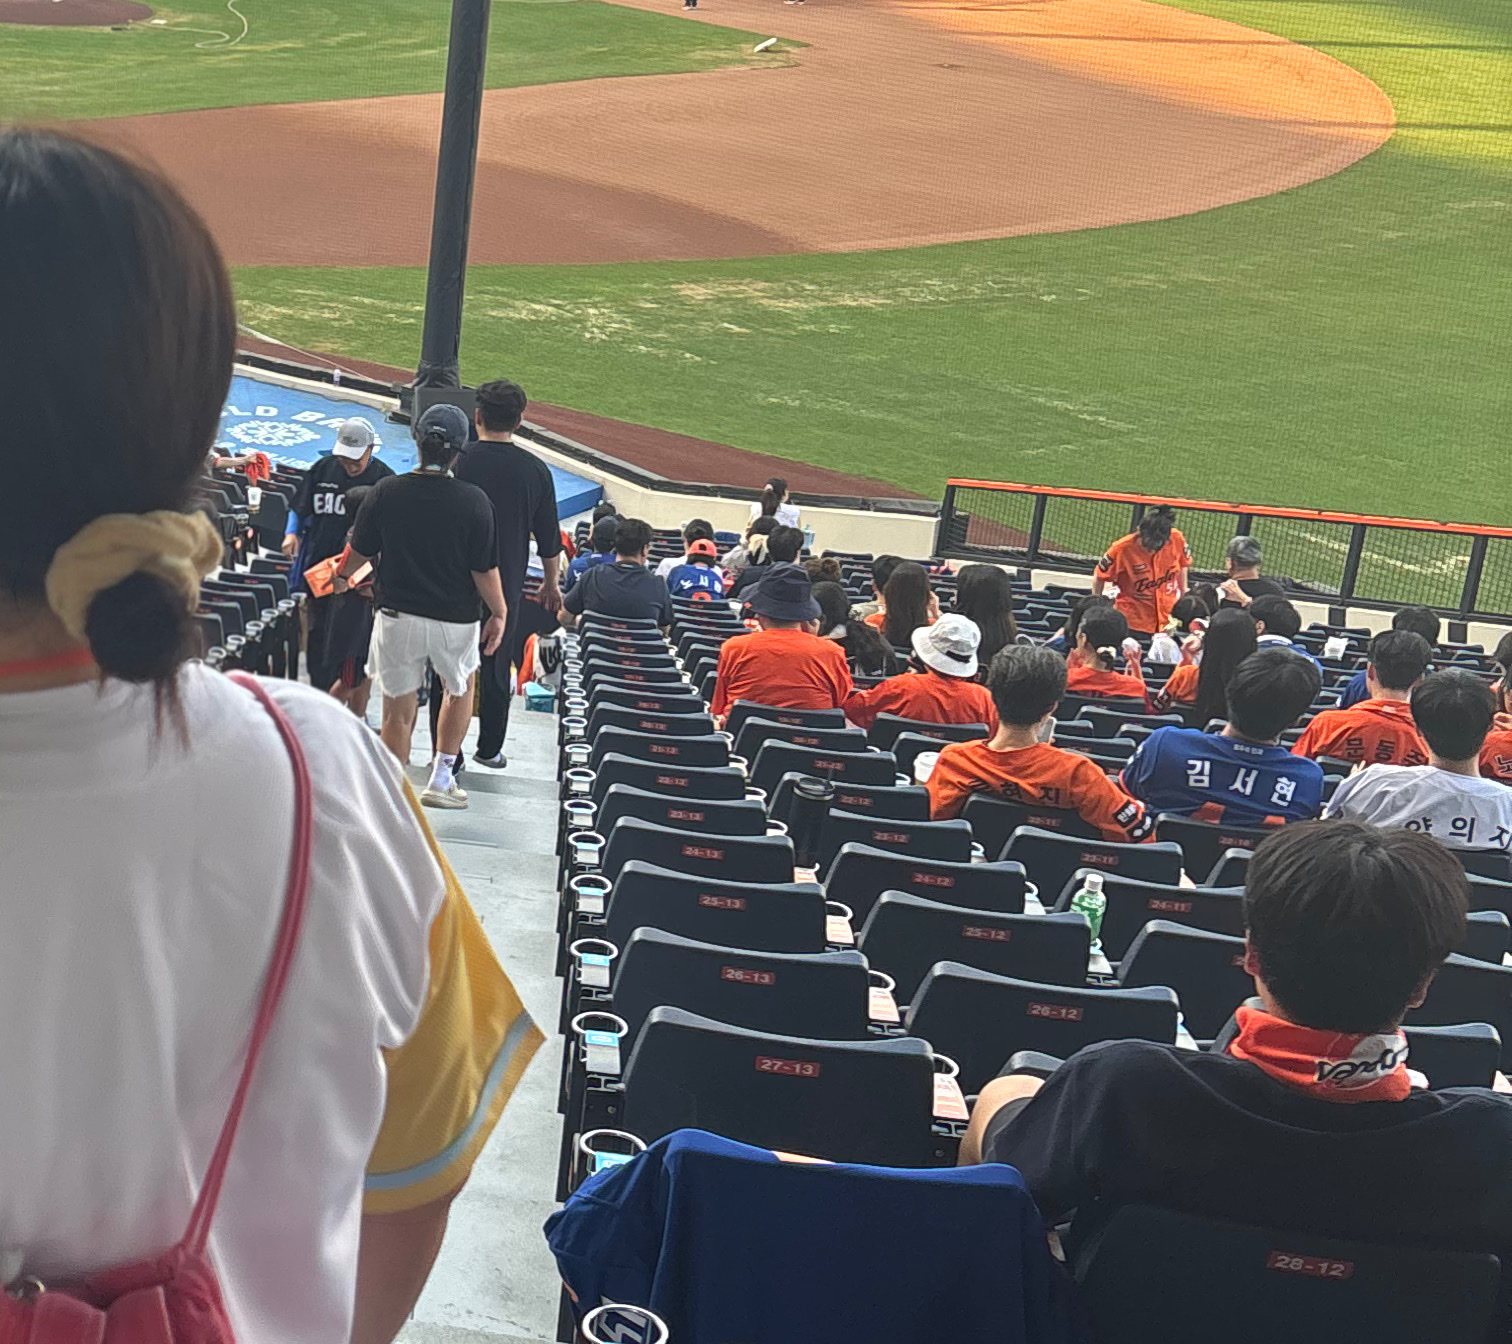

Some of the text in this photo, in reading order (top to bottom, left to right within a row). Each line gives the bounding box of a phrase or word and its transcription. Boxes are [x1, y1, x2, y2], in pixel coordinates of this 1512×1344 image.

[1186, 758, 1297, 807] 김서현
[702, 896, 741, 909] 25-13
[965, 927, 1007, 940] 25-12
[725, 968, 771, 984] 26-13
[1030, 1004, 1079, 1019] 26-12
[760, 1059, 814, 1075] 27-13
[1274, 1253, 1346, 1277] 28-12
